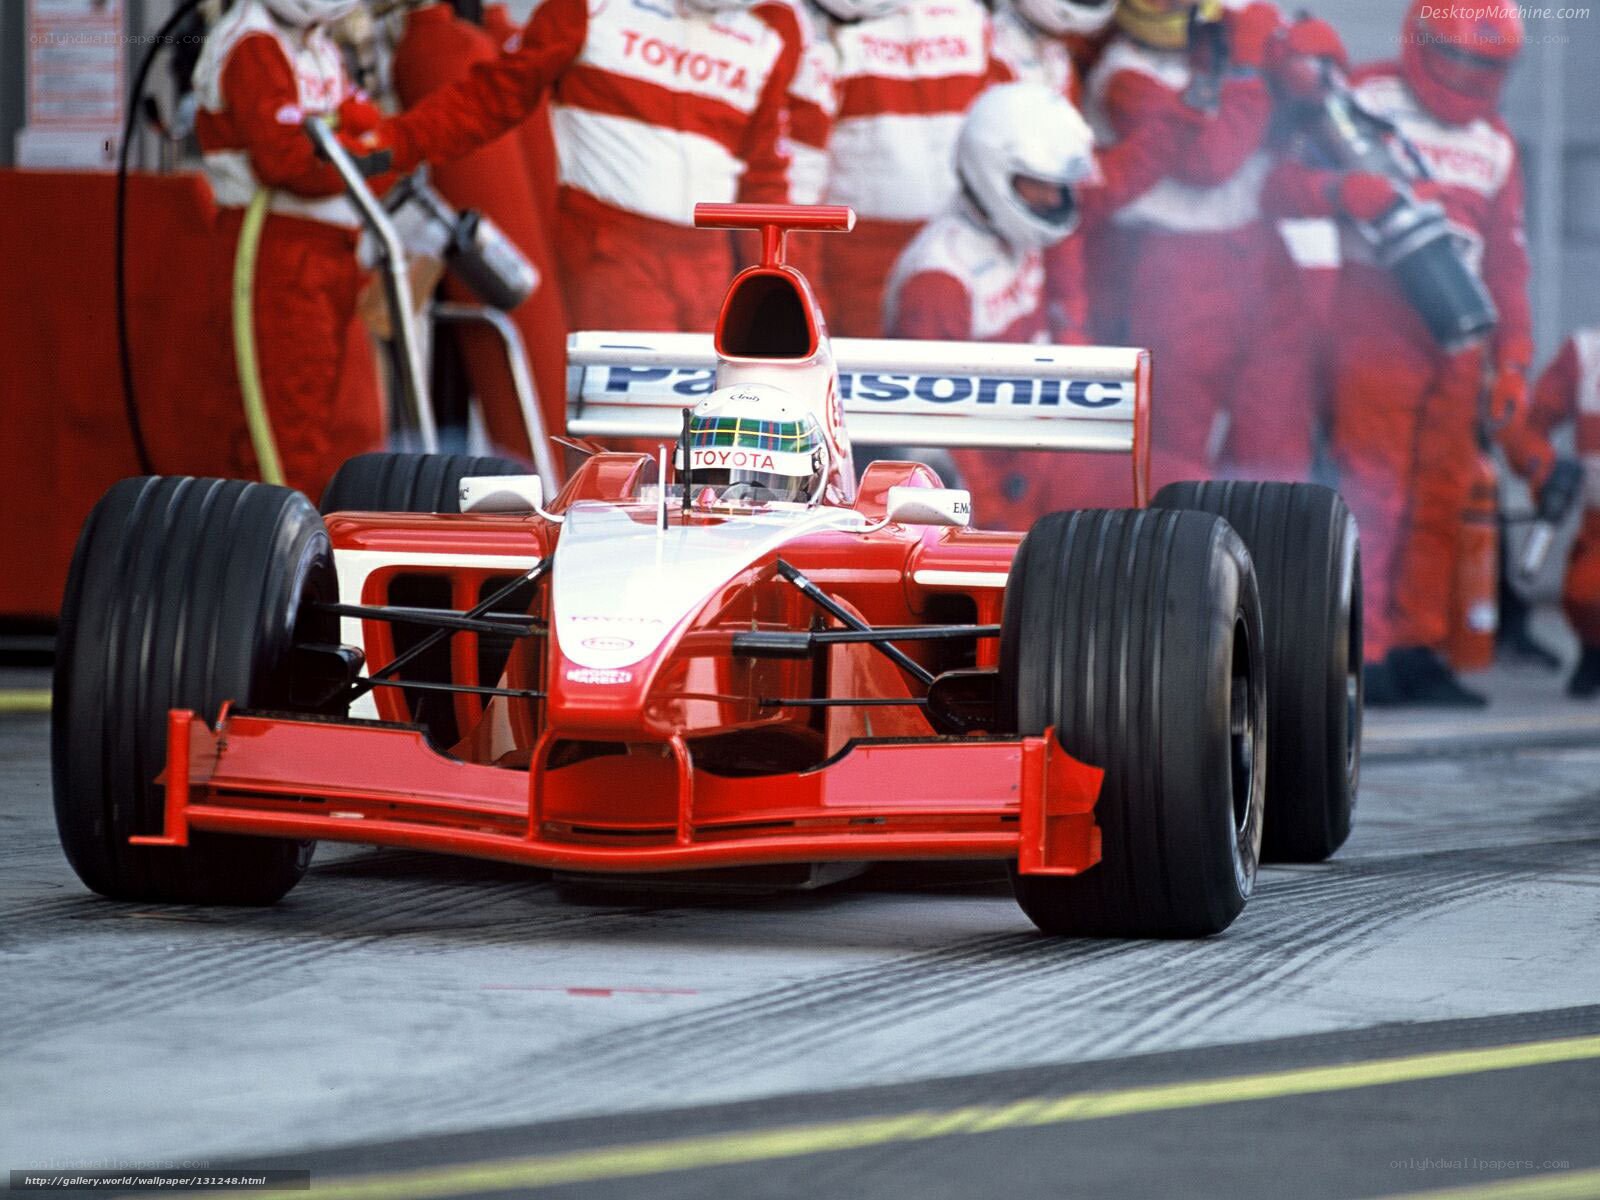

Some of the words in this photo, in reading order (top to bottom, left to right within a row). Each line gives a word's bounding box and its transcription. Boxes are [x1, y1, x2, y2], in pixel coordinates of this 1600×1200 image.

[621, 29, 748, 91] TOYOTA
[605, 367, 1123, 408] Pasonic
[694, 450, 775, 470] TOYOTA
